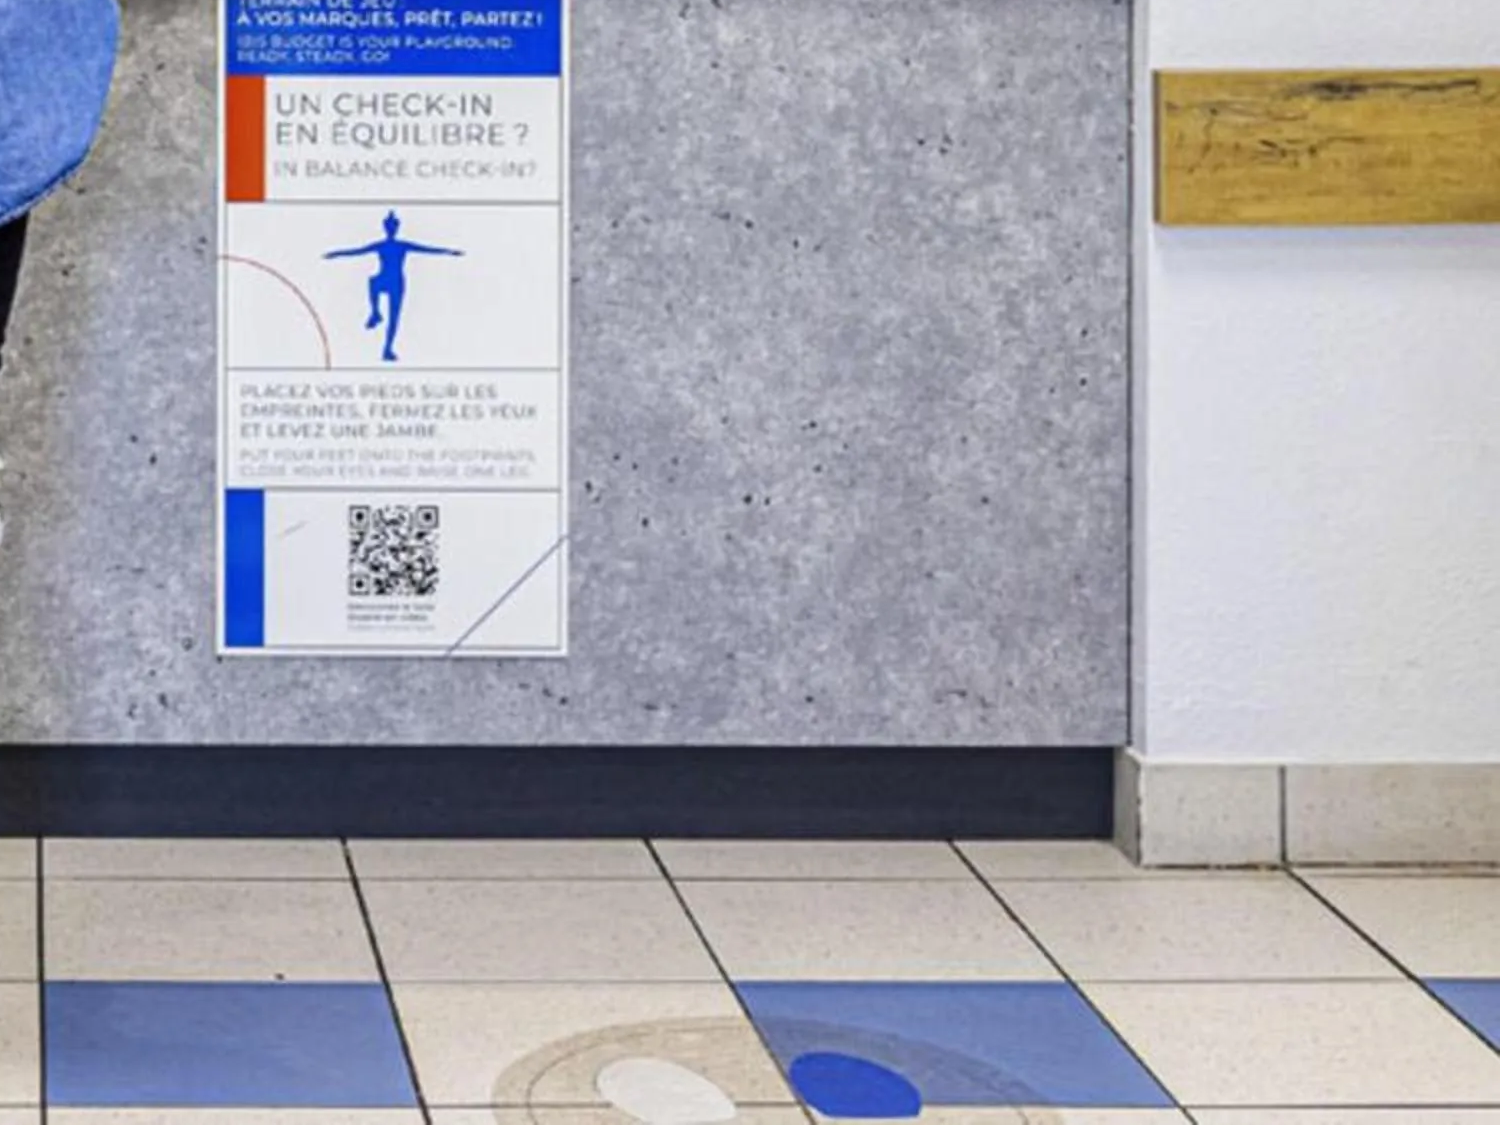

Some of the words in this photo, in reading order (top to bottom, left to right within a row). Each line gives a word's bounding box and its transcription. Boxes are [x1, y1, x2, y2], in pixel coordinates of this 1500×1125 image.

[254, 11, 294, 26] VOS
[299, 11, 399, 28] MARQUES,
[270, 35, 335, 49] BUDGET
[339, 35, 353, 49] IS
[358, 35, 400, 49] YOUR
[276, 93, 321, 117] UN
[332, 93, 493, 117] CHECK-IN
[276, 124, 318, 146] EN
[331, 119, 505, 149] ÉQUILIBRE
[514, 124, 530, 146] ?
[274, 160, 298, 179] IN
[305, 160, 408, 179] BALANCE
[415, 160, 537, 179] CHECK-IN?
[240, 384, 311, 399] PLACEZ
[316, 384, 353, 399] VOS
[359, 384, 416, 399] PIEDS
[421, 384, 459, 399] SUR
[465, 384, 498, 399] LES
[369, 403, 444, 419] FERMEZ
[450, 403, 484, 419] LES
[490, 403, 537, 419] YEUX
[240, 423, 261, 438] ET
[266, 423, 325, 438] LEVEZ
[330, 423, 368, 438] UNE
